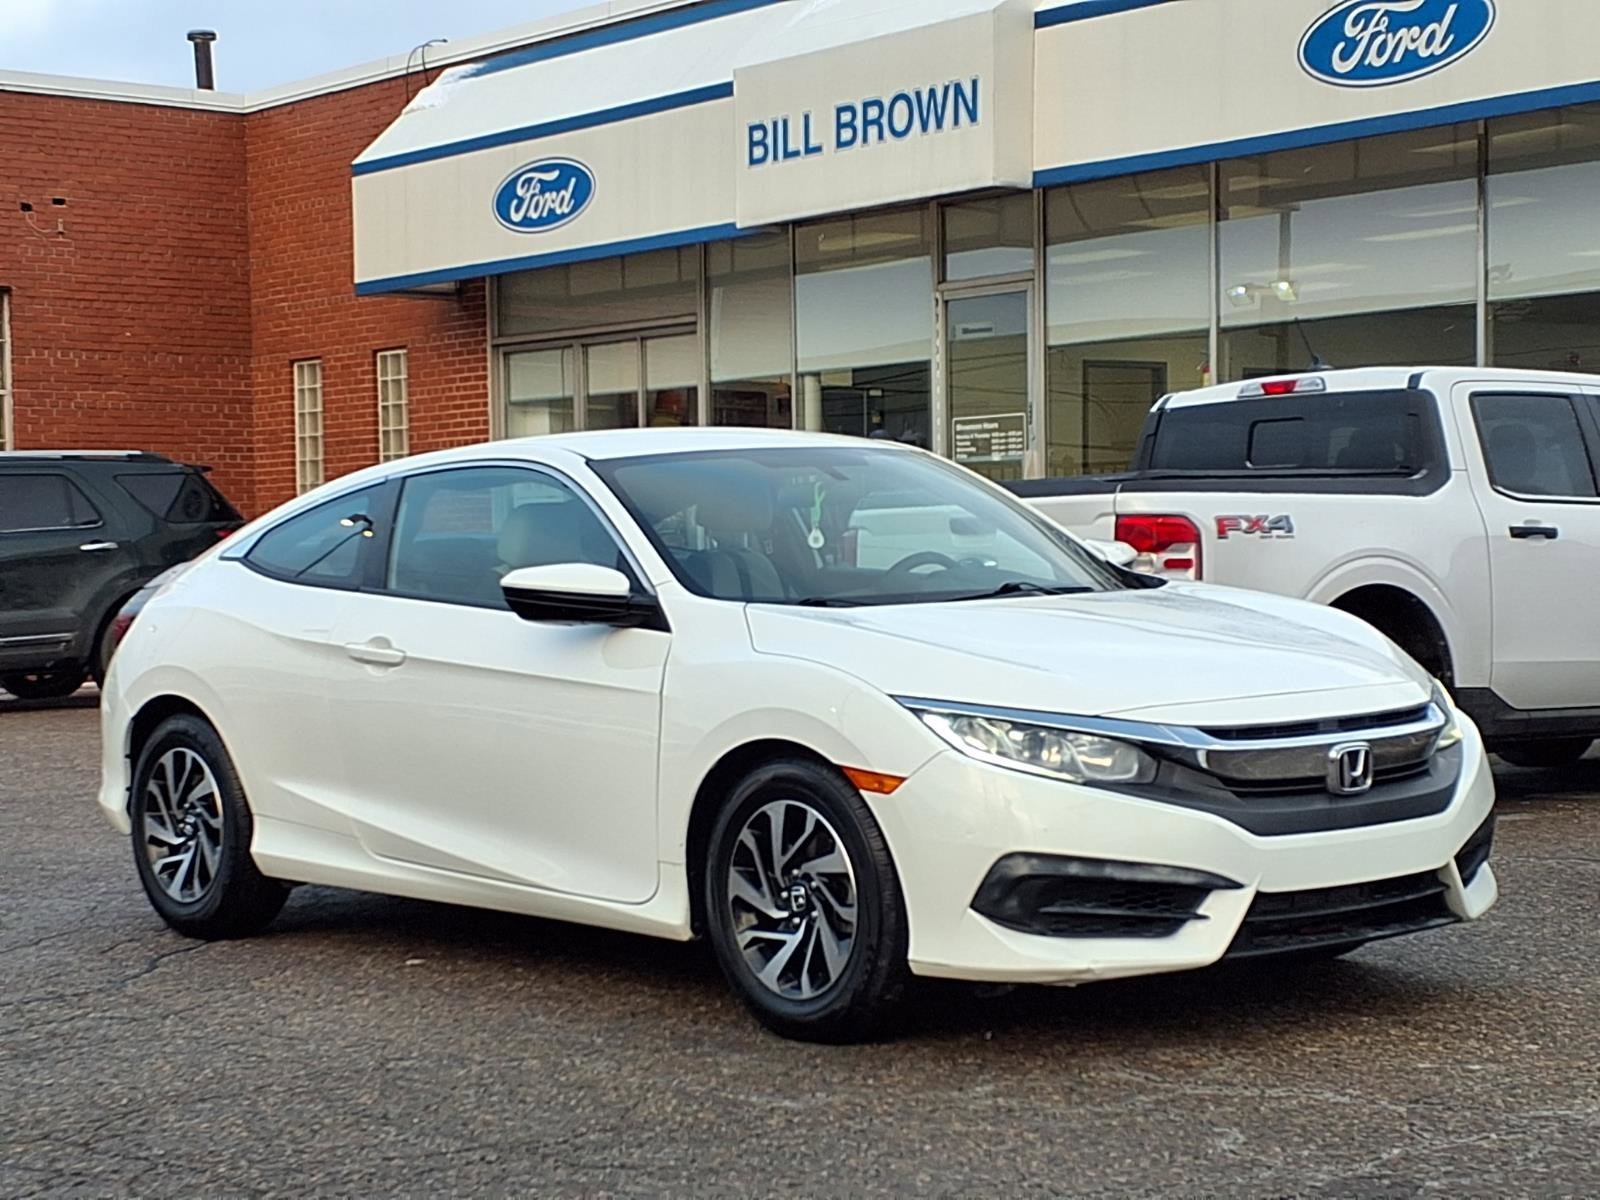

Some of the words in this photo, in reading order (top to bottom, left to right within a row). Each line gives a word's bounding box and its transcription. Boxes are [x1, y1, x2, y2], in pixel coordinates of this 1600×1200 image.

[1332, 0, 1458, 73] Ford
[748, 112, 823, 167] BILL
[834, 77, 979, 150] BROWN
[510, 168, 576, 223] Ford
[1214, 514, 1294, 539] FX4
